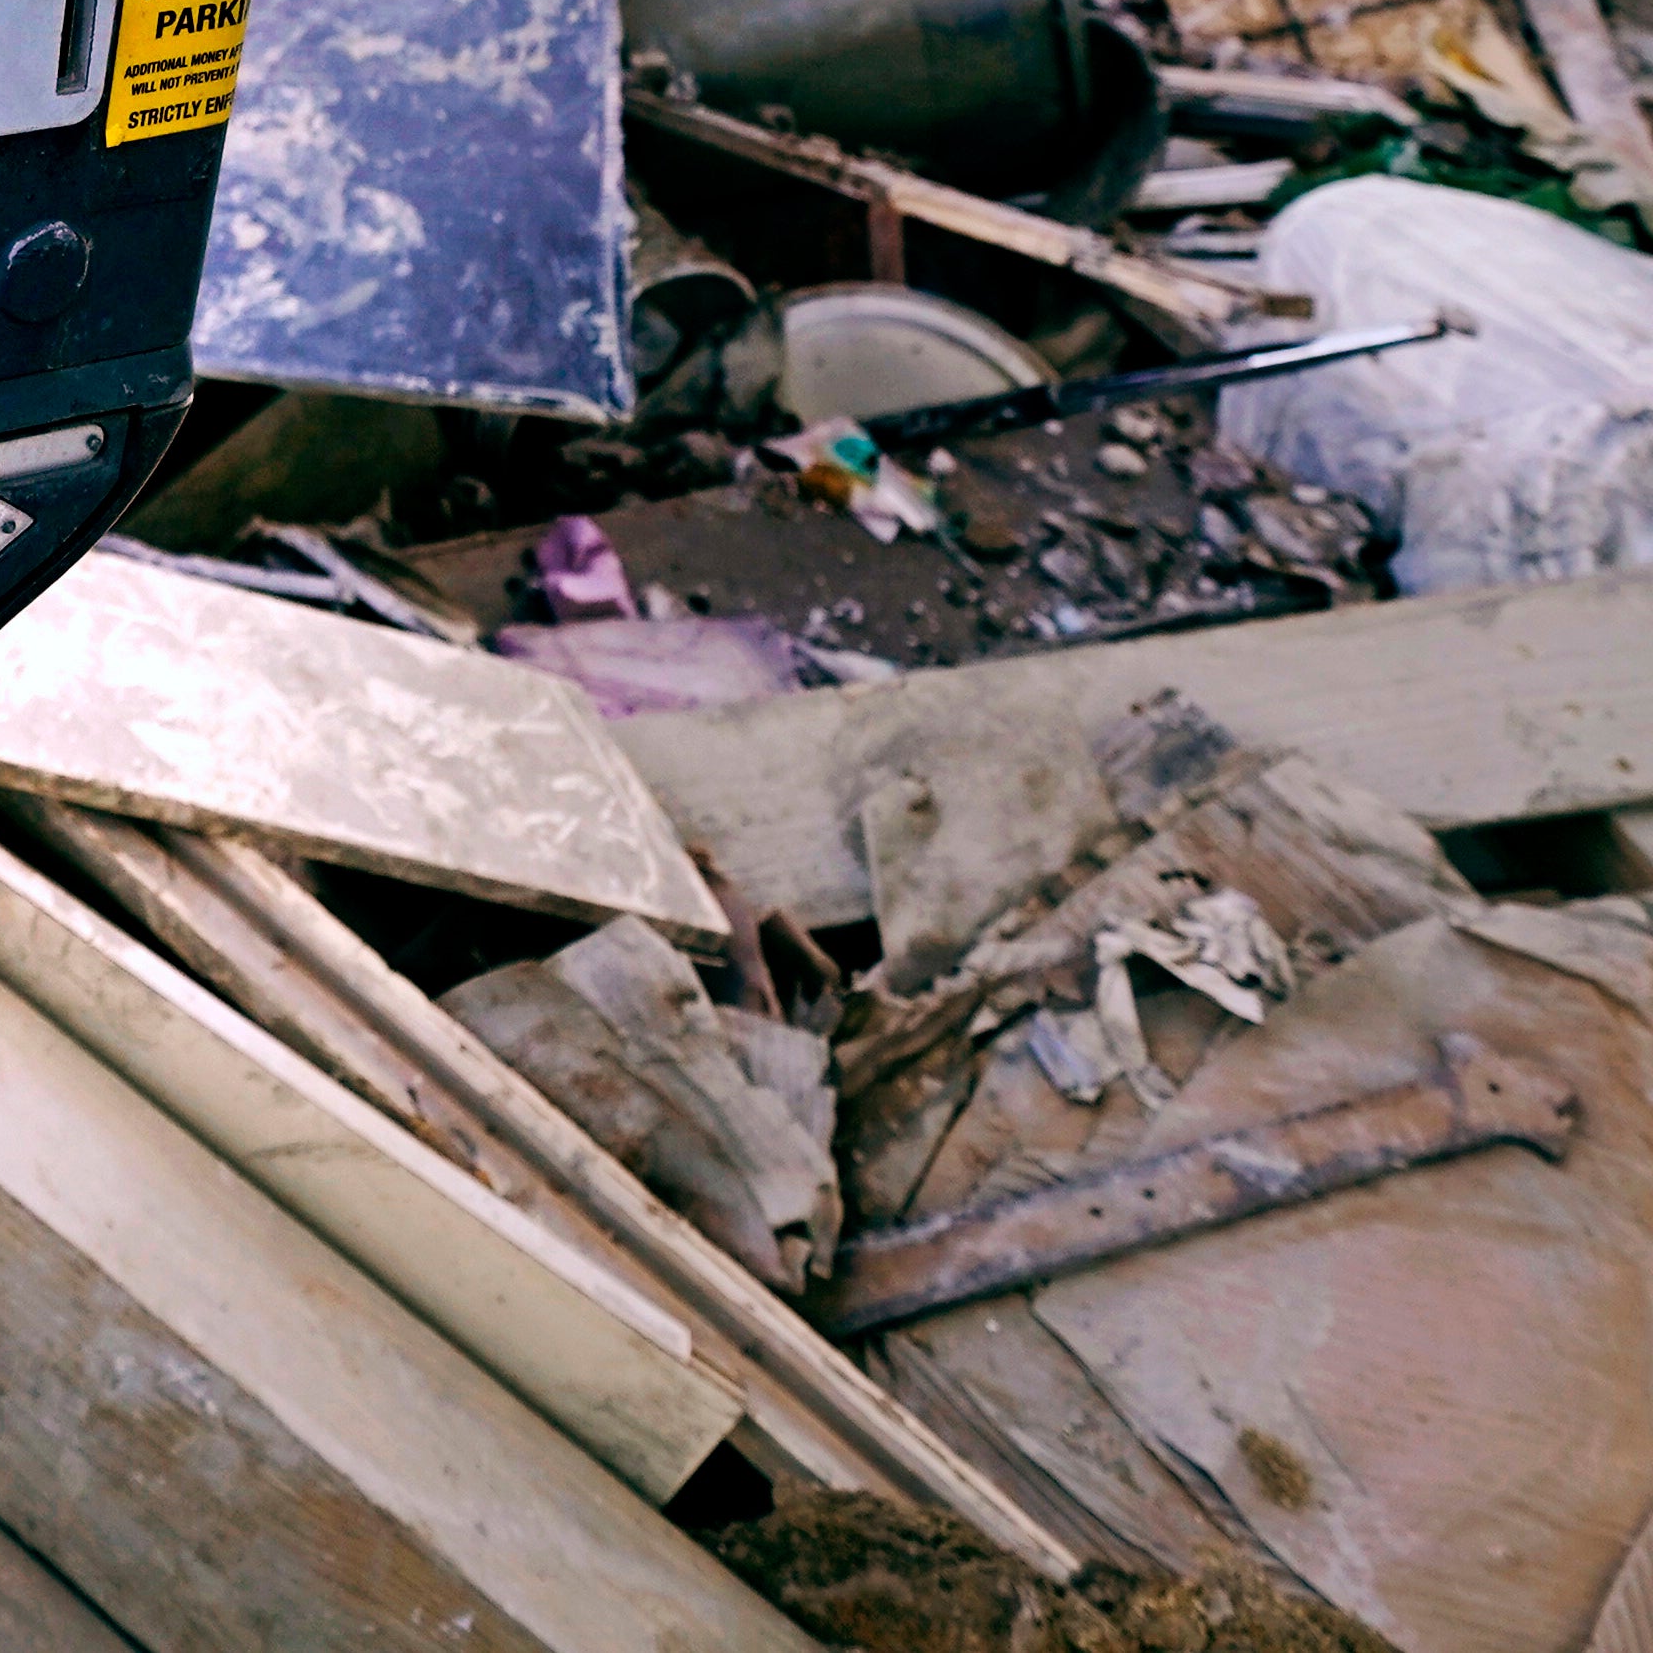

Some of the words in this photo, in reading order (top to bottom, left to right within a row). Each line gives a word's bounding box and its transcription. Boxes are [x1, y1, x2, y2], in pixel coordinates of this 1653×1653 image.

[124, 57, 187, 79] ADDITIONAL
[191, 48, 229, 67] MONEY
[131, 82, 156, 96] WILL
[159, 76, 180, 90] NOT
[183, 66, 230, 87] PREVENT
[127, 99, 202, 129] STRICTLY
